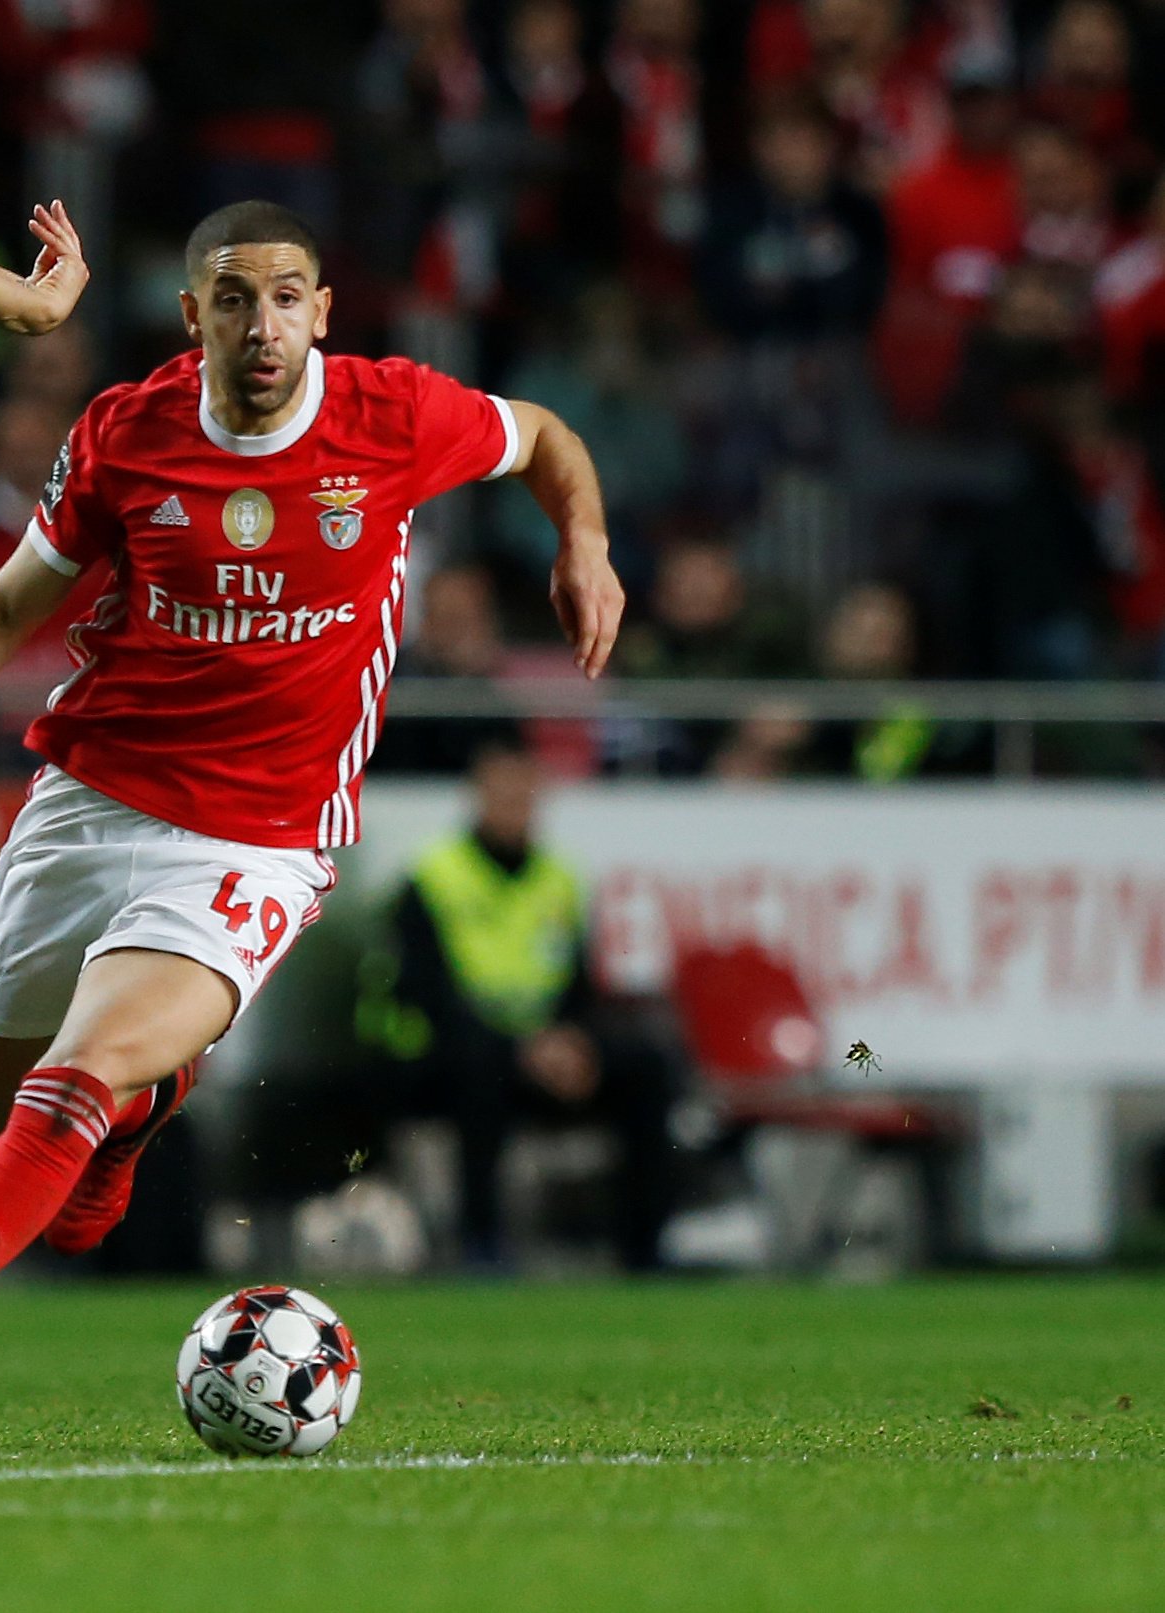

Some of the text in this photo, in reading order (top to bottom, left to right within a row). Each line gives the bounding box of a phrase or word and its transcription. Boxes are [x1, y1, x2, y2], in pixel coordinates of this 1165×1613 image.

[147, 583, 356, 644] Emirates
[216, 563, 285, 605] Fly
[208, 870, 289, 962] 49
[197, 1382, 284, 1444] SELECT
